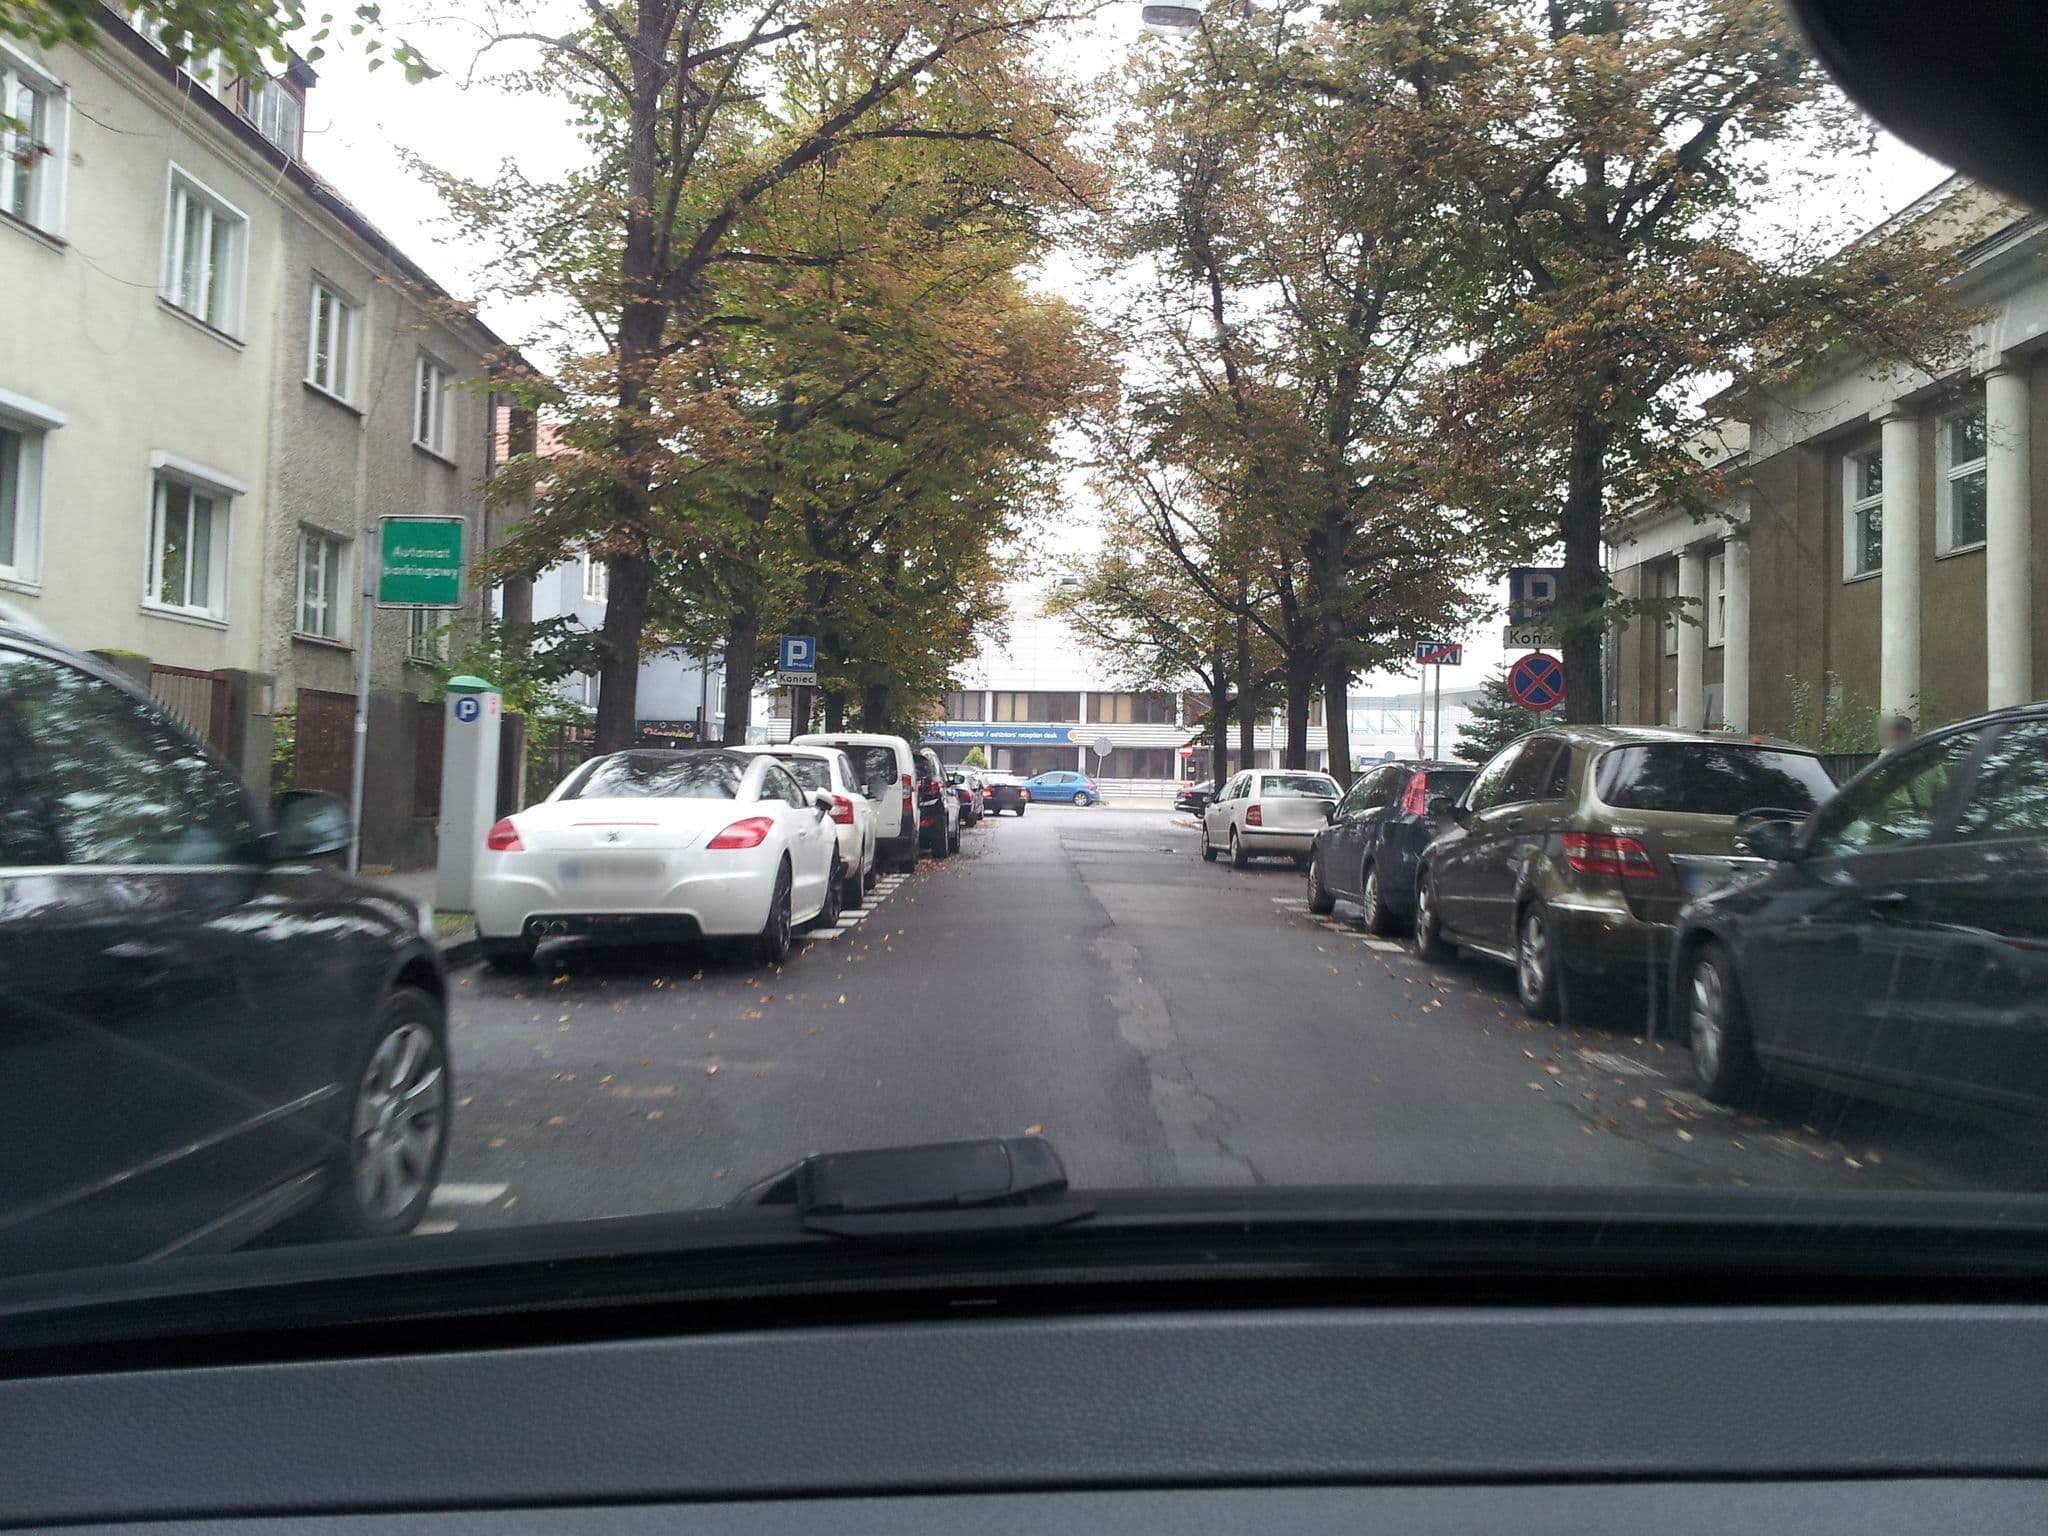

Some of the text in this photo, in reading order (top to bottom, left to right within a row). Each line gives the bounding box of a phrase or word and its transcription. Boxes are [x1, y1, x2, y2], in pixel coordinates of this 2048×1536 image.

[392, 546, 452, 558] Automat
[384, 565, 459, 580] parkingowy
[1523, 574, 1556, 618] P
[787, 640, 807, 667] P
[1418, 644, 1461, 664] TAXI
[780, 674, 814, 684] Koniec
[460, 700, 477, 719] P
